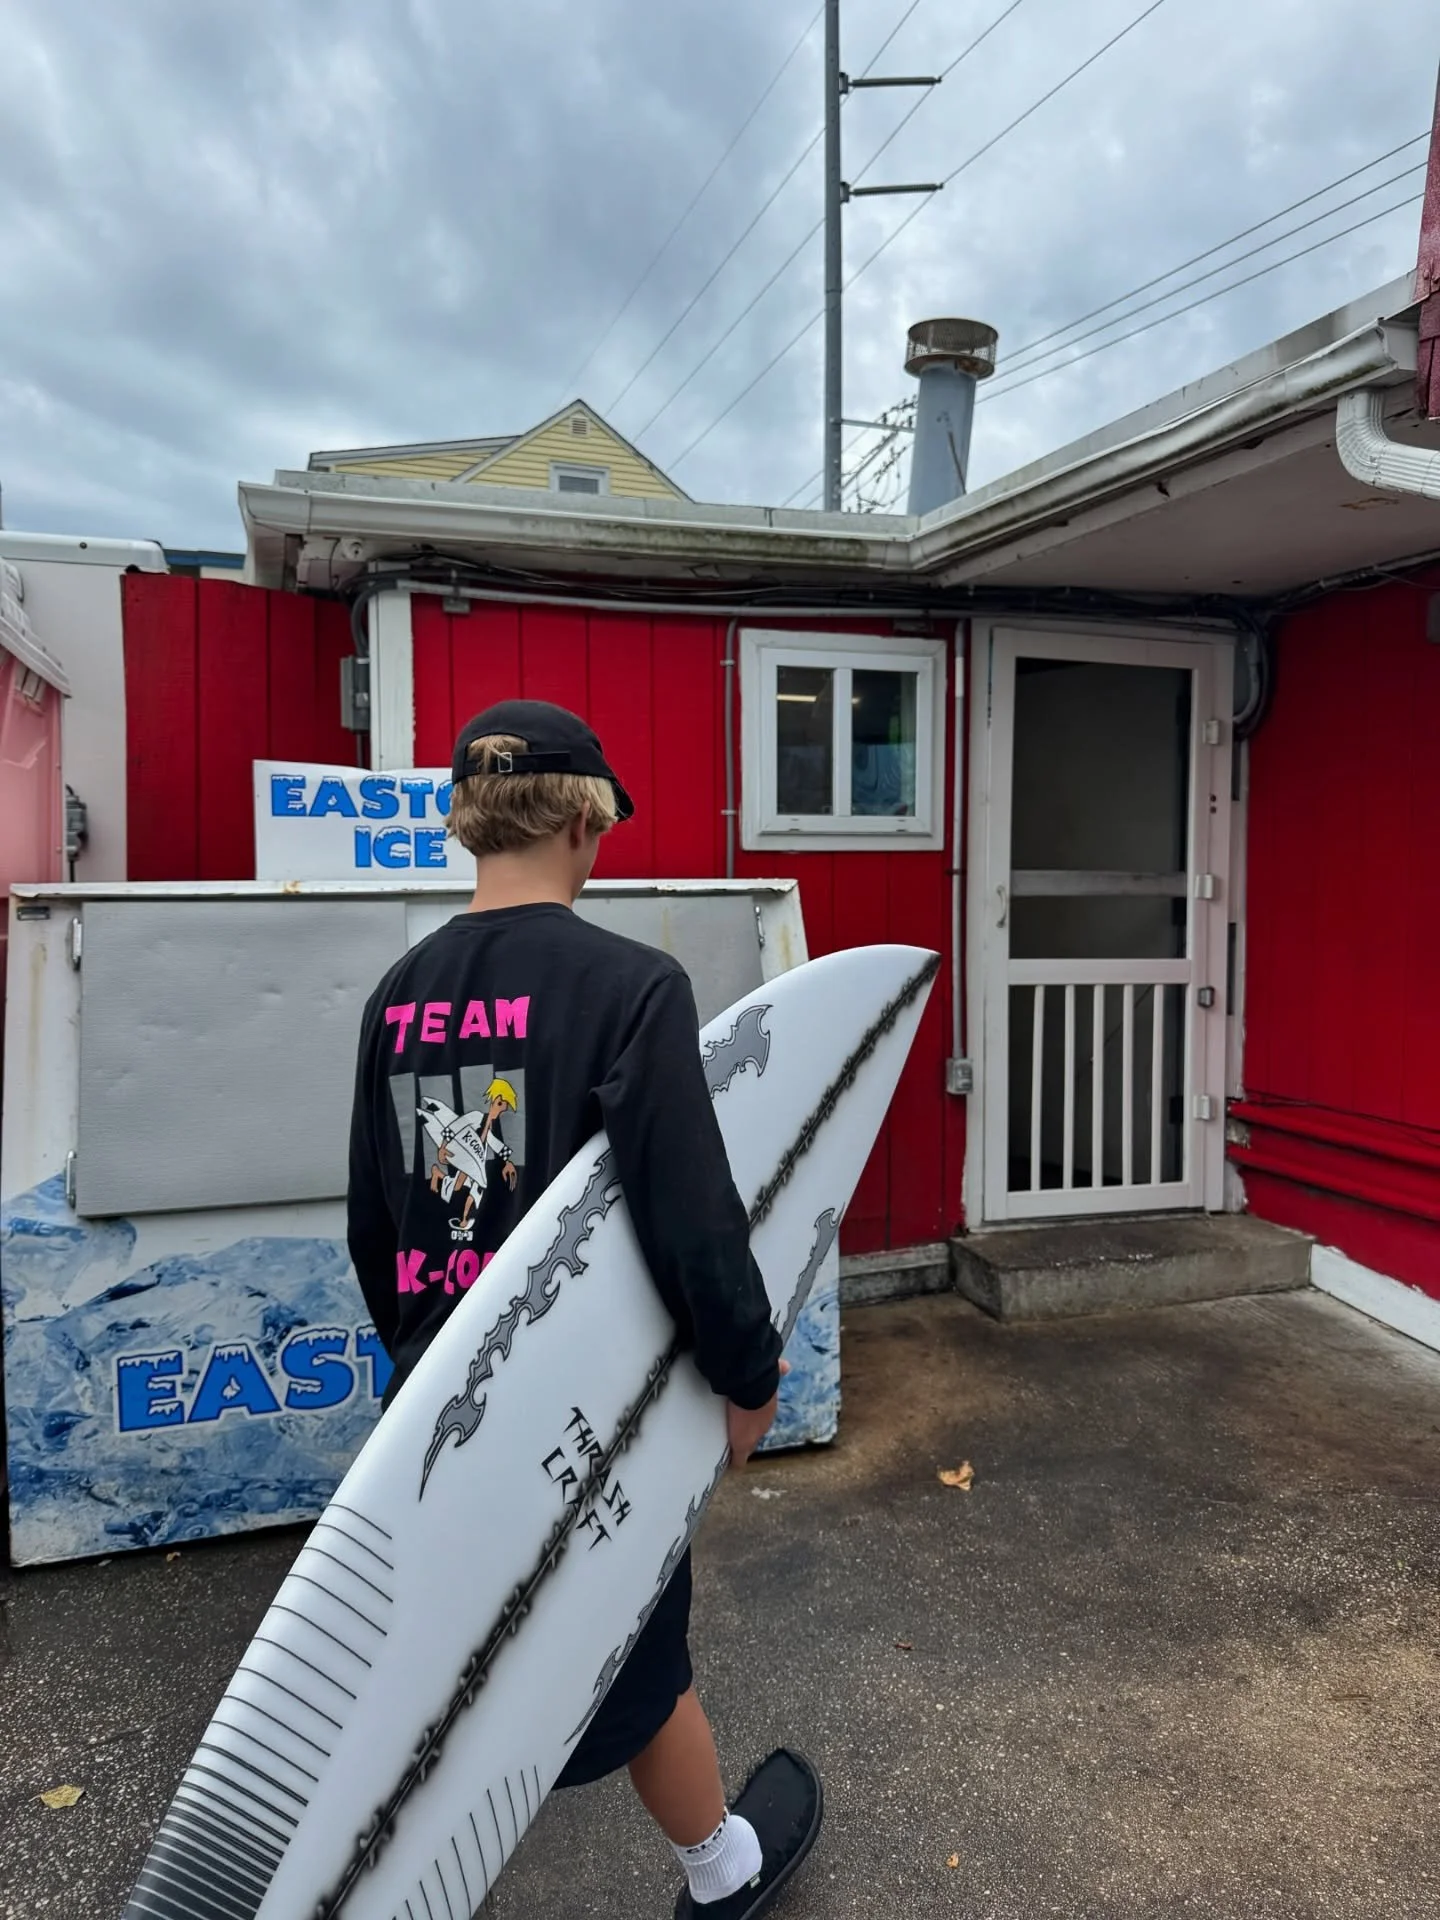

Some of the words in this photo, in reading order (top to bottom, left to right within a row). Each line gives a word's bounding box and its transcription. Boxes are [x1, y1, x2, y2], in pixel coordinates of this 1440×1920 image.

[354, 825, 448, 869] ICE
[385, 995, 531, 1054] TEAM
[541, 1446, 613, 1552] CRAFT
[563, 1406, 633, 1527] THRASH
